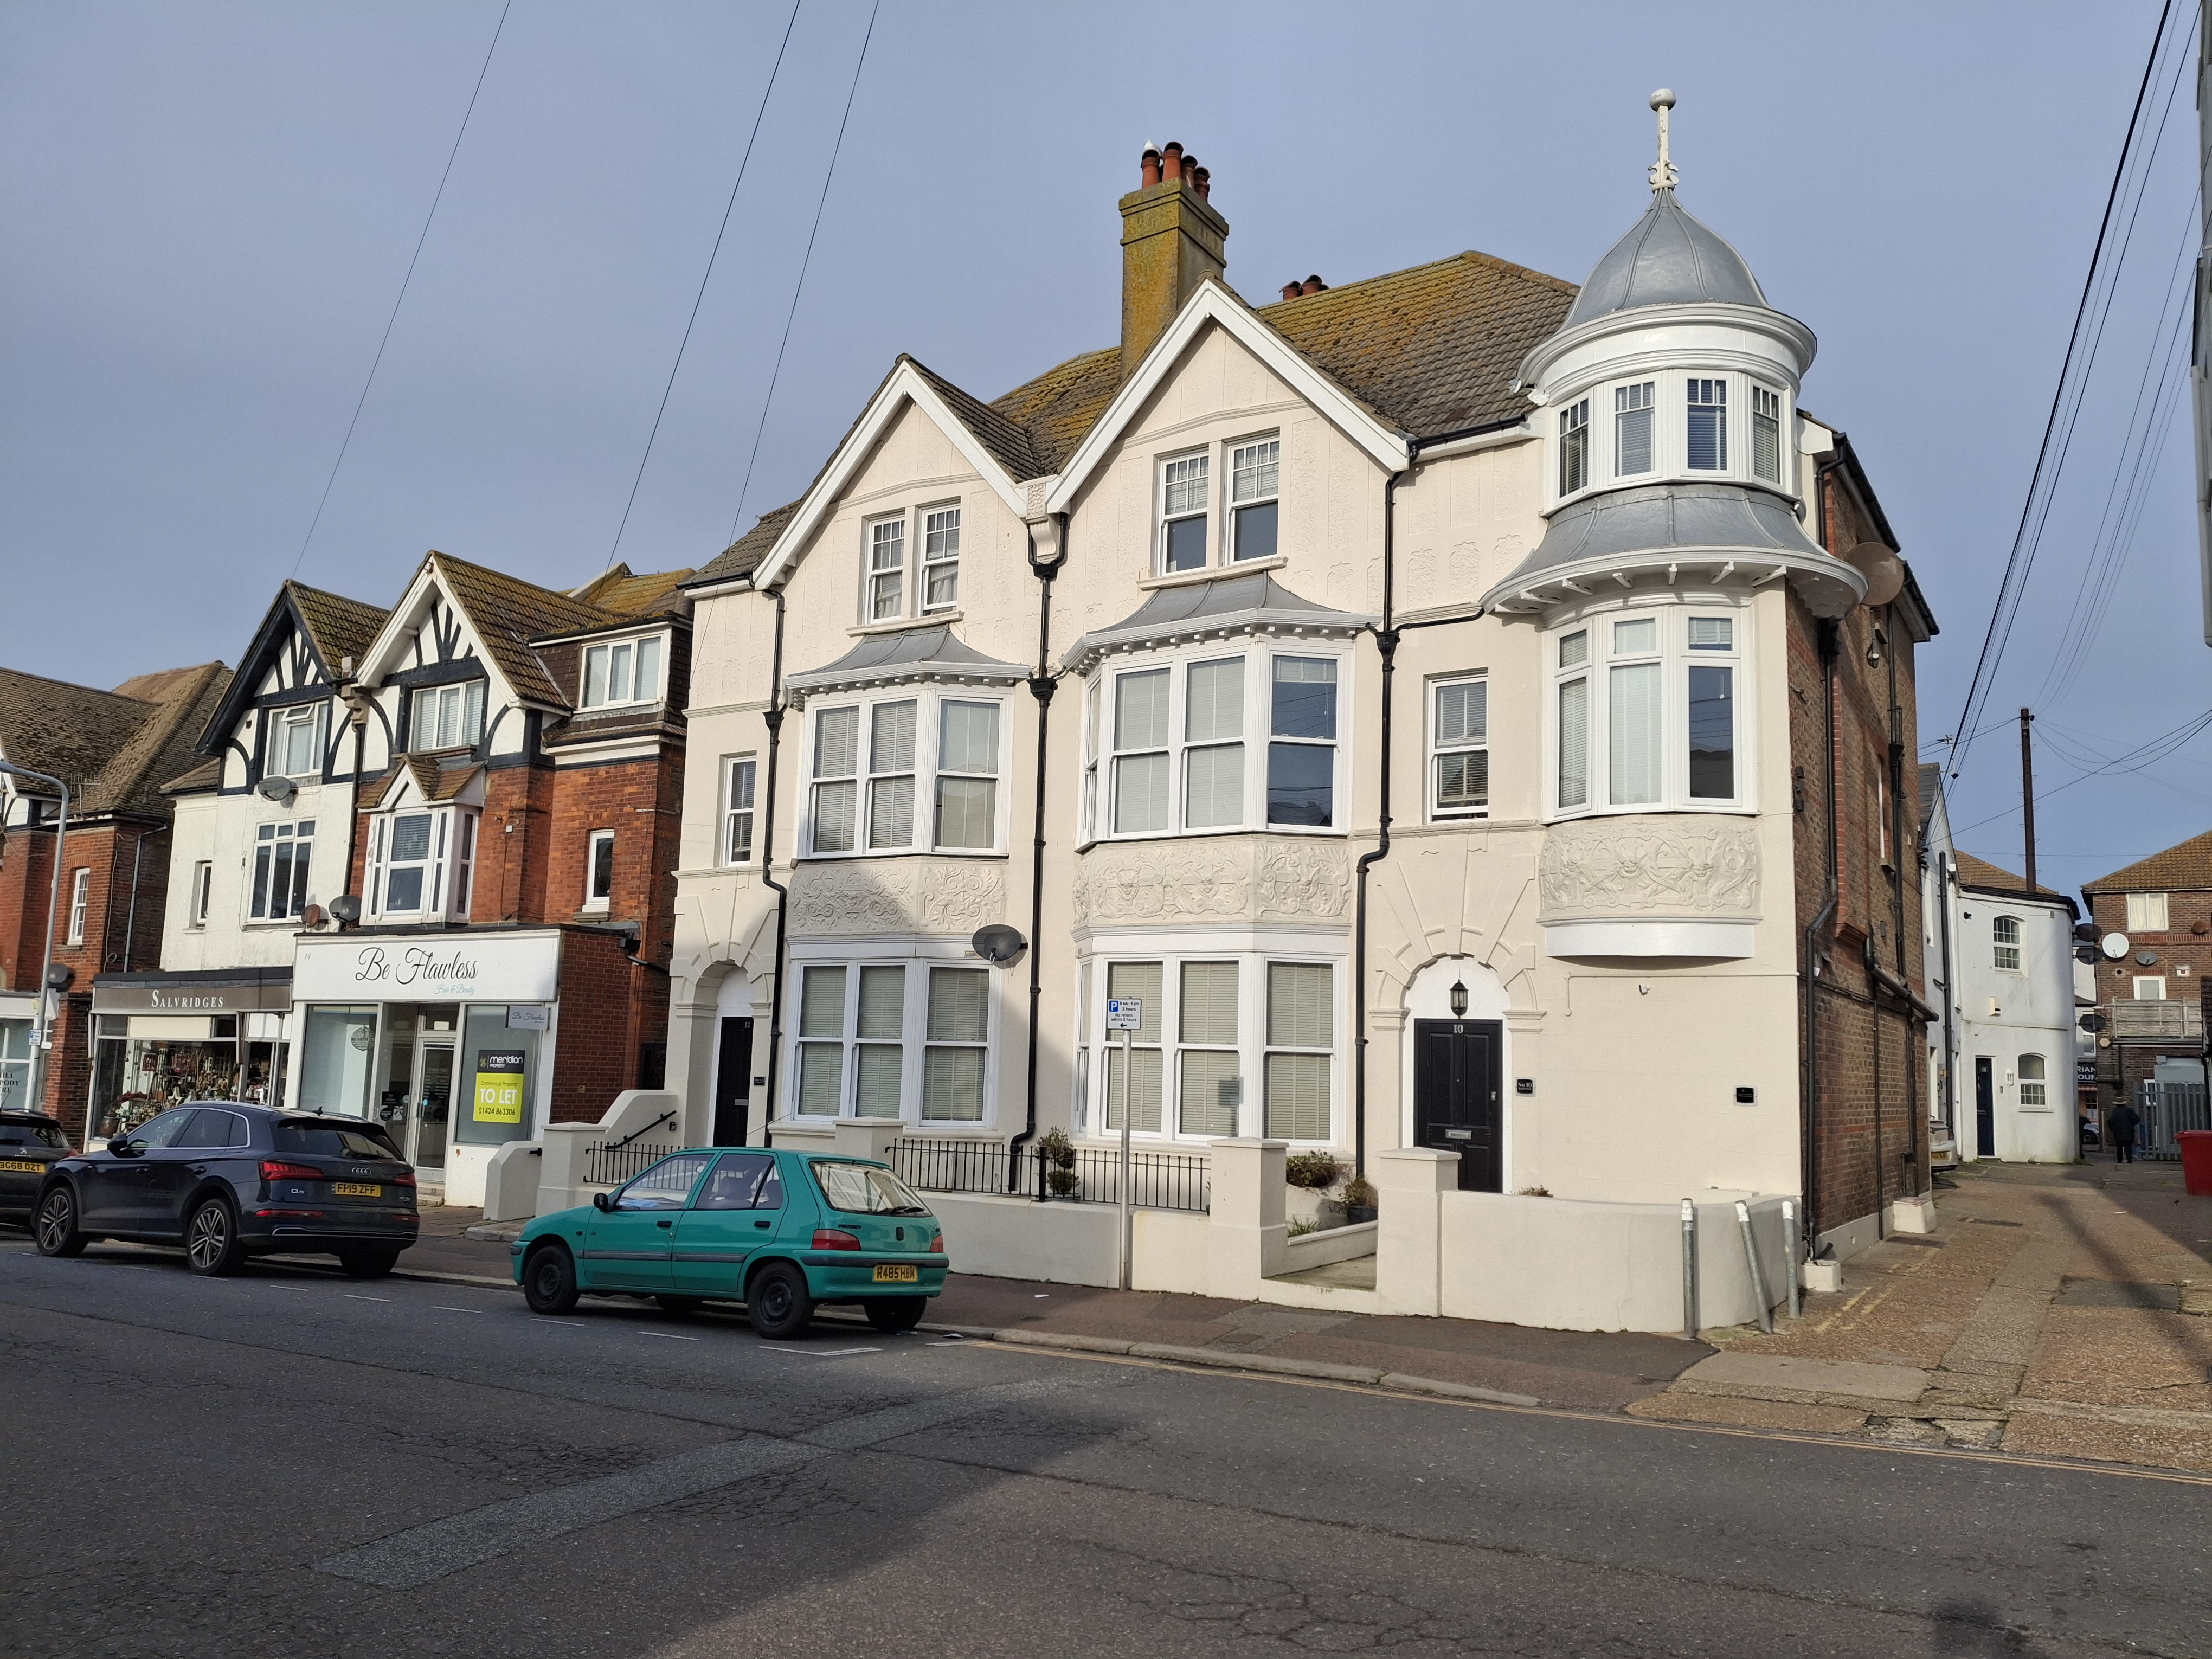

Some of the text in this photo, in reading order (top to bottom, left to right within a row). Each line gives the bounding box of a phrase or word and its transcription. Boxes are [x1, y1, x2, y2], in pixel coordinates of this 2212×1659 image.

[356, 947, 479, 985] Be Flawless
[1453, 1024, 1464, 1033] 10
[490, 1055, 523, 1064] meridian
[480, 1088, 517, 1104] TO LET
[478, 1107, 516, 1116] 01424 863306
[337, 1184, 376, 1194] FP19 ZFF
[877, 1266, 899, 1279] R485
